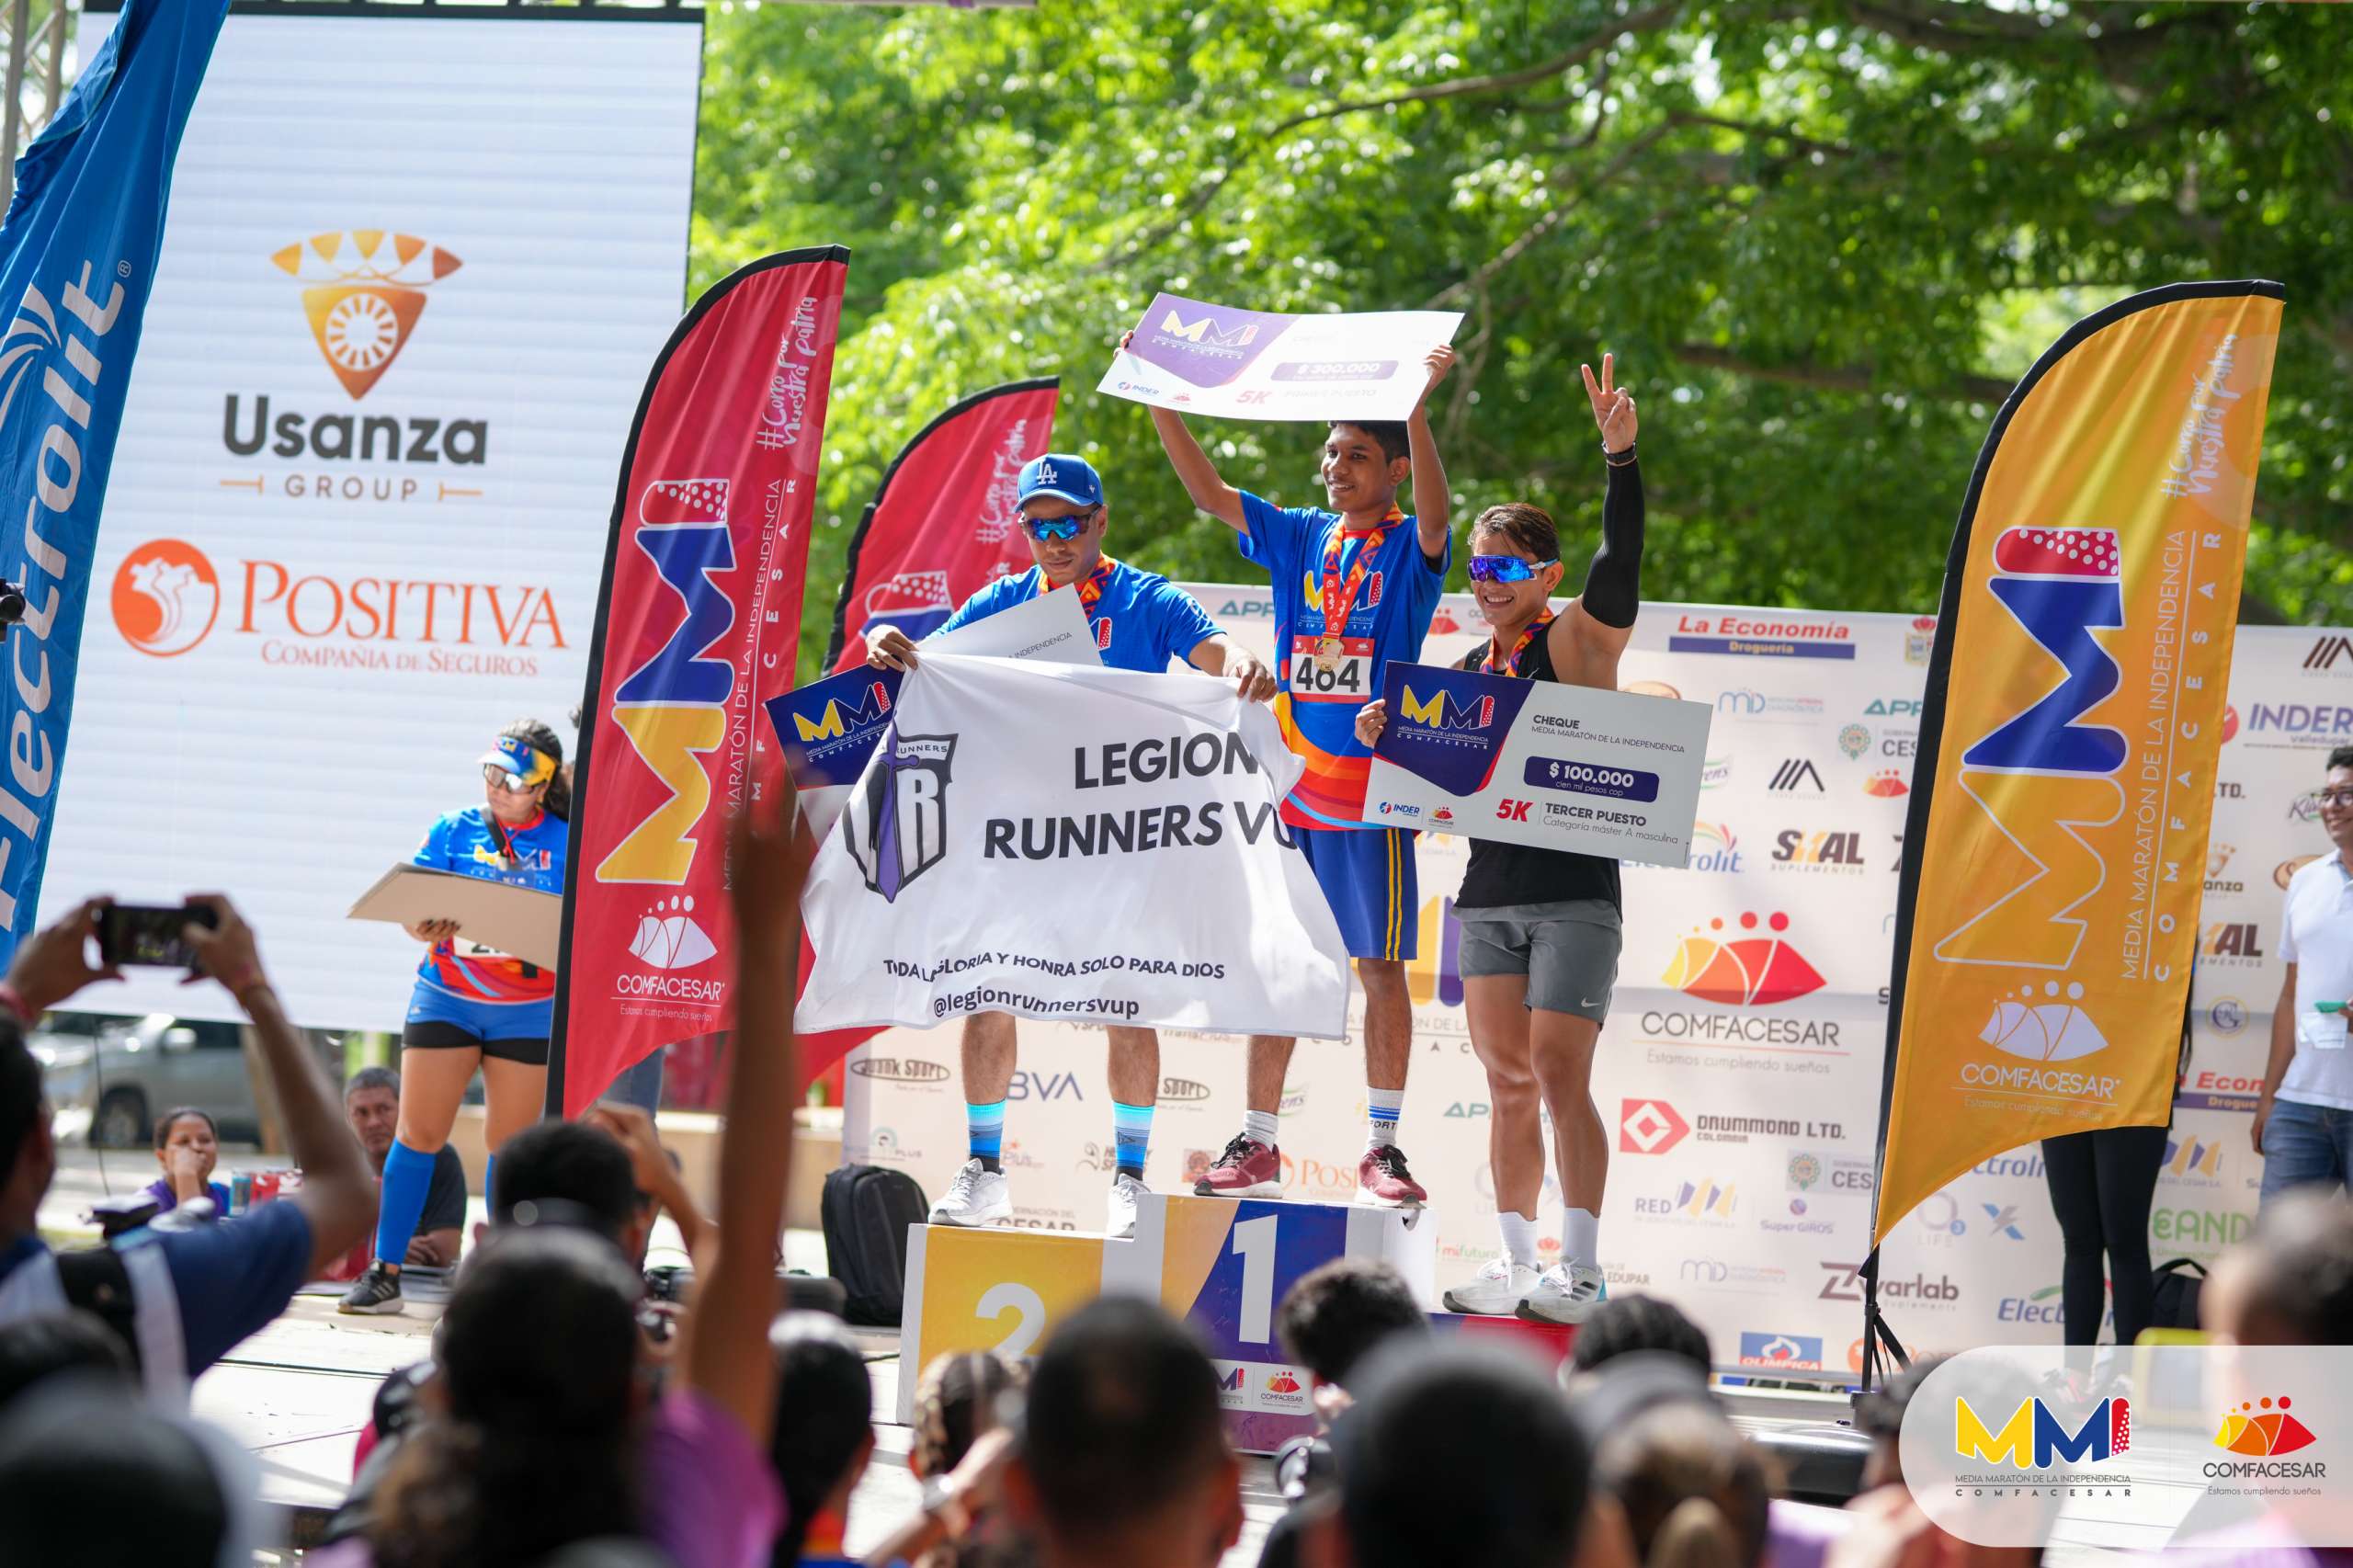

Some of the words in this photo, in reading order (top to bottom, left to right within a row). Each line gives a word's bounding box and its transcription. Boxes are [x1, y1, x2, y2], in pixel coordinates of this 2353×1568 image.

[790, 297, 817, 357] patria
[2208, 334, 2241, 400] patria
[1236, 390, 1273, 405] 5K
[222, 393, 487, 465] Usanza
[1037, 460, 1057, 485] LA
[285, 474, 418, 500] GROUP
[746, 479, 781, 643] INDEPENDENCIA
[236, 559, 570, 649] POSITIVA
[1677, 615, 1710, 634] La
[1719, 617, 1850, 640] Economía
[2149, 530, 2186, 710] INDEPENDENCIA
[1014, 631, 1073, 659] INDEPENDENCIA
[429, 649, 538, 678] SEGUROS
[740, 649, 753, 676] LA
[734, 681, 750, 709] DE
[1532, 714, 1580, 730] CHEQUE
[2146, 716, 2165, 745] LA
[2248, 702, 2353, 734] INDER
[1451, 733, 1489, 743] INDEPENDENCIA
[1531, 725, 1555, 735] MEDIA
[1557, 728, 1597, 742] MARATÓN
[1598, 734, 1608, 744] DE
[1609, 736, 1620, 745] LA
[1622, 738, 1685, 753] INDEPENDENCIA
[1881, 739, 1917, 758] CES
[1074, 731, 1259, 790] LEGION
[2143, 753, 2163, 780] DE
[2154, 532, 2222, 983] COMFACESAR
[1549, 762, 1560, 778] $
[1564, 765, 1634, 788] 100.000
[1555, 780, 1572, 790] cien
[1573, 781, 1584, 791] mil
[1585, 785, 1608, 796] pesos
[1608, 788, 1624, 798] cop
[2216, 781, 2245, 799] TD.
[1392, 803, 1420, 815] INDER
[1495, 799, 1533, 823] 5K
[1545, 802, 1593, 820] TERCER
[1597, 810, 1647, 827] PUESTO
[983, 801, 1224, 860] RUNNERS
[1543, 815, 1590, 832] Categoría
[1592, 823, 1621, 837] máster
[1635, 832, 1678, 845] masculina
[2133, 787, 2159, 901] MARATÓN
[1771, 862, 1865, 875] SUPLEMENTOS
[2202, 881, 2244, 892] anza
[2120, 910, 2145, 980] MEDIA
[996, 952, 1010, 965] Y
[1013, 954, 1076, 978] HONRA
[1080, 955, 1125, 975] SOLO
[1129, 960, 1177, 976] PARA
[1182, 963, 1225, 980] DIOS
[617, 974, 722, 1001] COMFACESAR
[934, 986, 1140, 1020] @legionrunnersvup
[1641, 1011, 1840, 1047] COMFACESAR
[1647, 1050, 1700, 1067] Estamos
[1704, 1052, 1780, 1074] cumpliendo
[1784, 1058, 1831, 1074] sueños
[1007, 1072, 1083, 1102] BVA
[1961, 1062, 2116, 1100] COMFACESAR
[2197, 1073, 2266, 1093] Econ
[1697, 1114, 1801, 1137] DRUMMOND
[1807, 1121, 1847, 1140] LTD.
[1831, 1171, 1873, 1190] CES
[1635, 1198, 1672, 1214] RED
[1760, 1220, 1795, 1233] Super
[1797, 1221, 1834, 1235] GIROS
[1233, 1213, 1279, 1345] 1
[1608, 1274, 1651, 1286] EDUPAR
[974, 1282, 1047, 1358] 2
[1260, 1392, 1304, 1403] COMFACESAR
